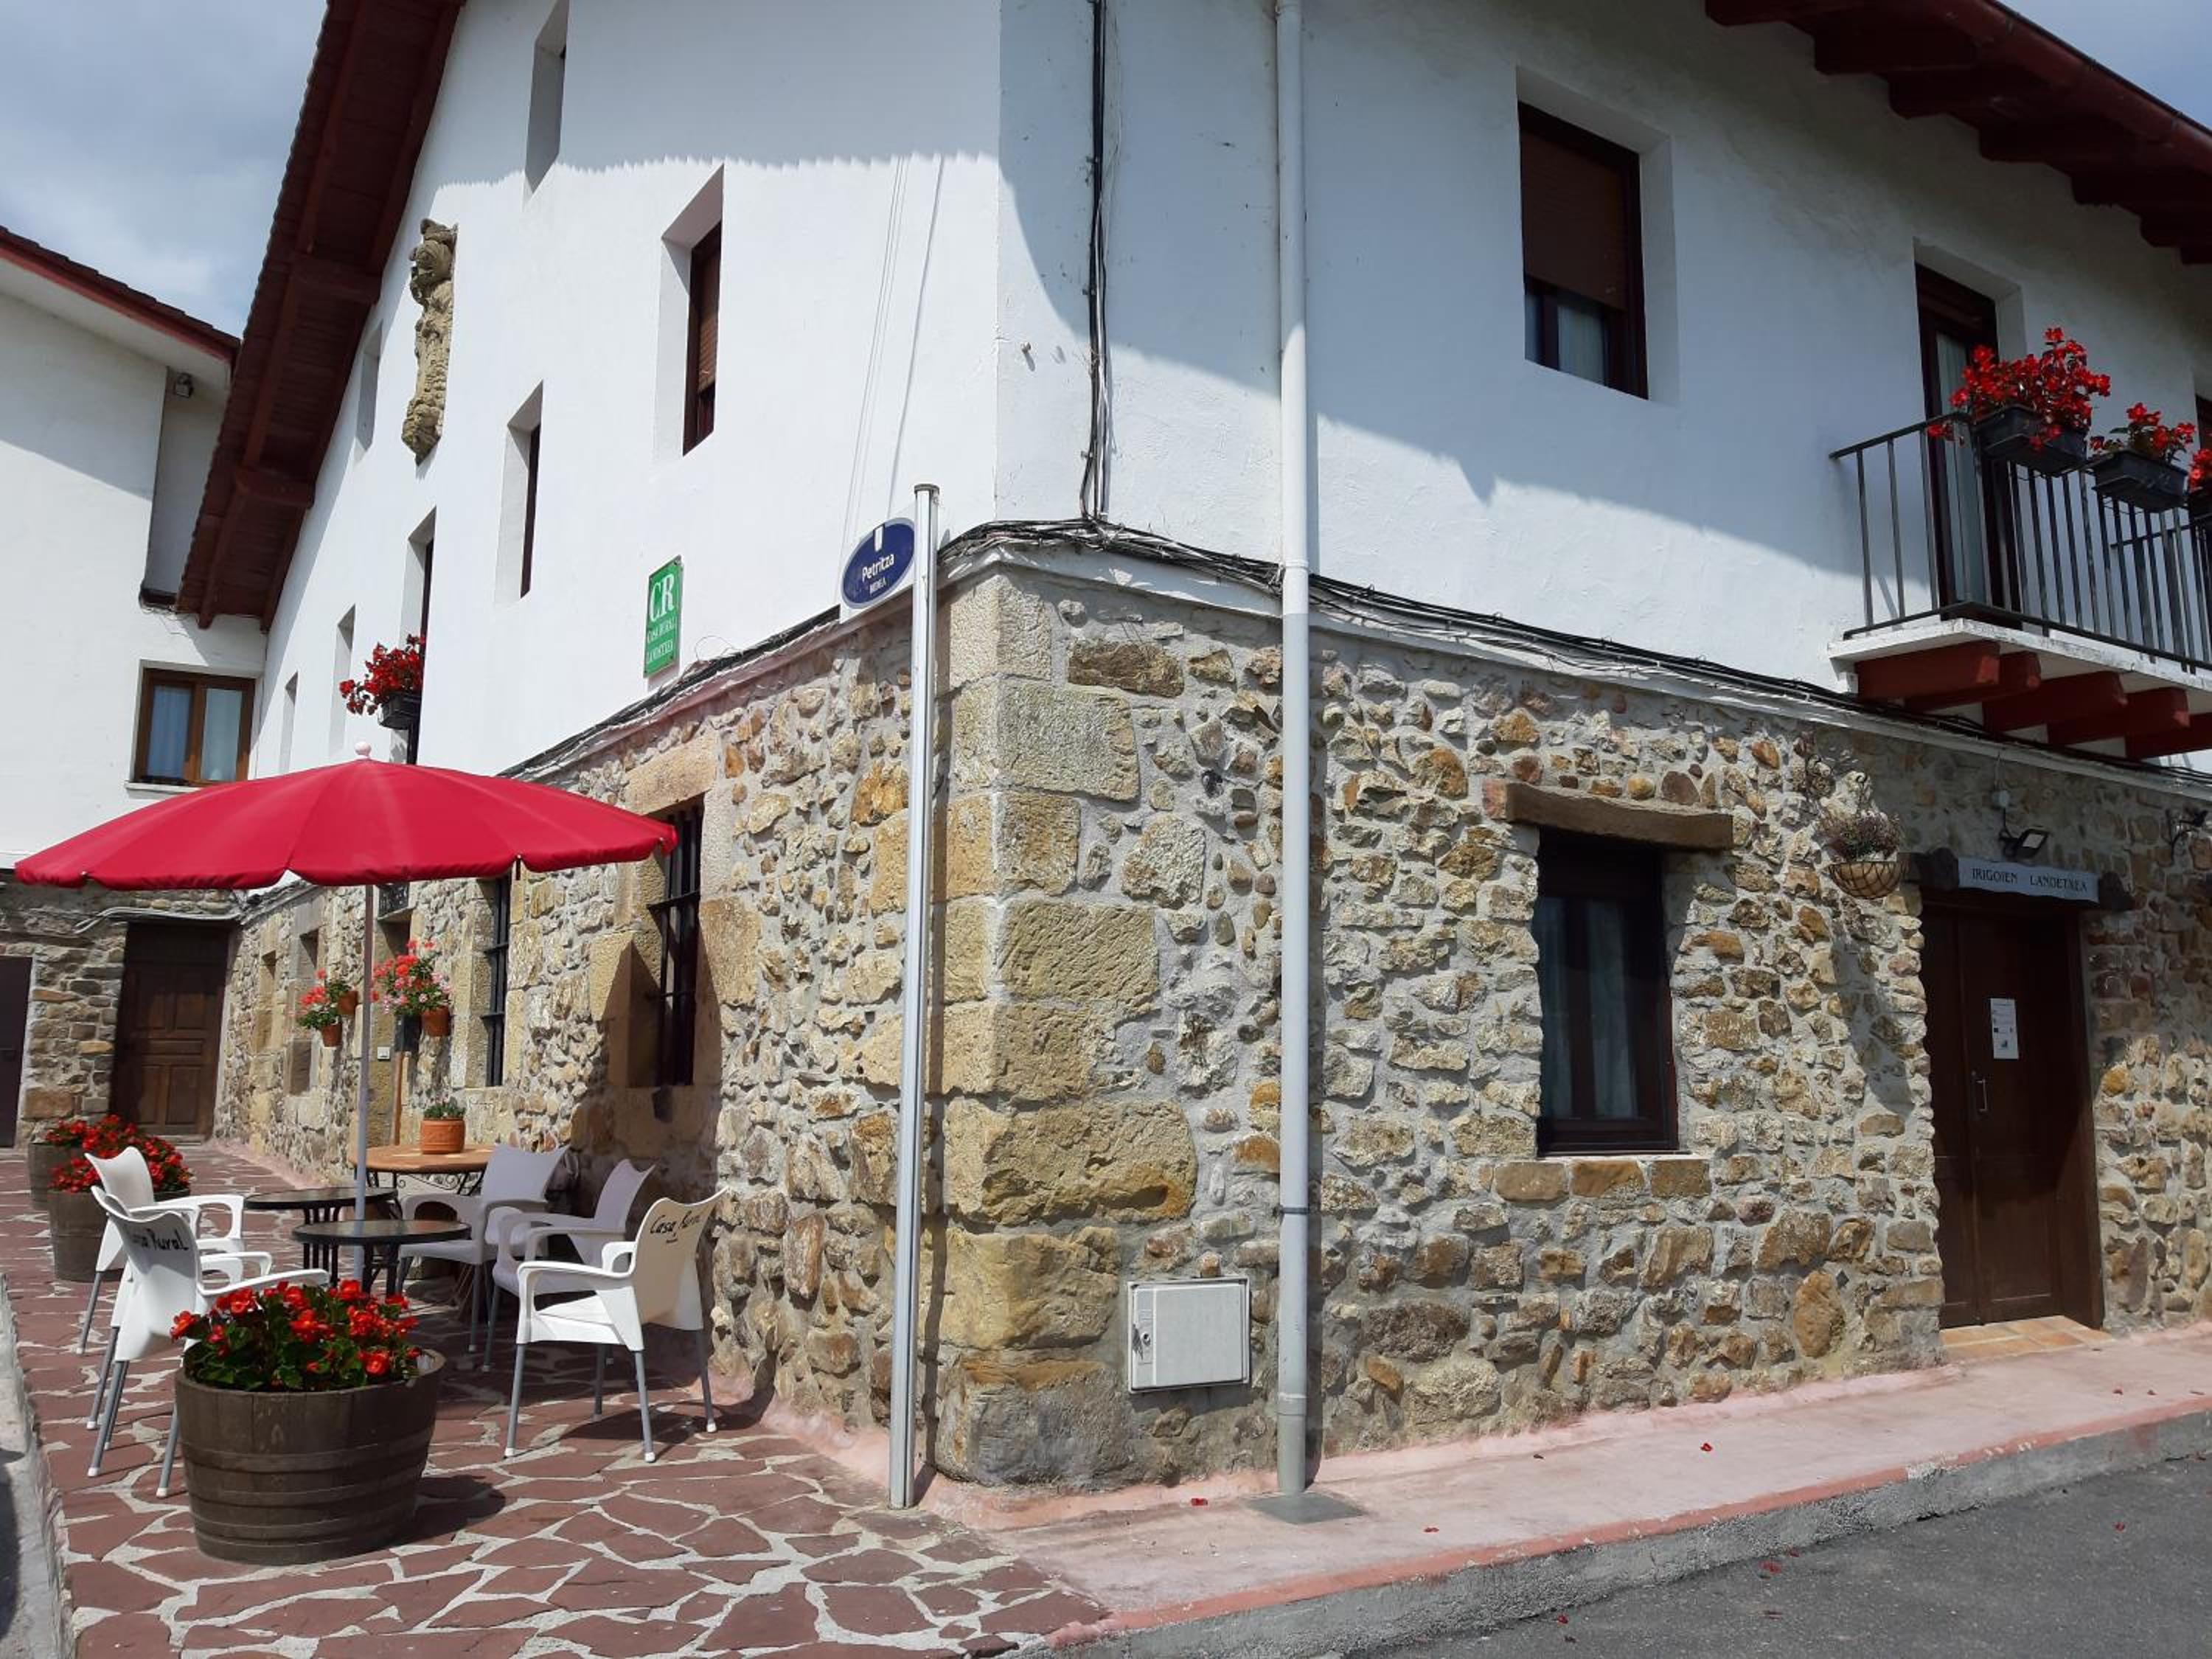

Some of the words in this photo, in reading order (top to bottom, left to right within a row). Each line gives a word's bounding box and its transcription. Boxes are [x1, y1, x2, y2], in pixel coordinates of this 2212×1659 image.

[862, 554, 894, 582] Petritza
[650, 573, 675, 622] CR
[1972, 868, 2018, 883] IRIGOIEN
[650, 1214, 677, 1234] Casa
